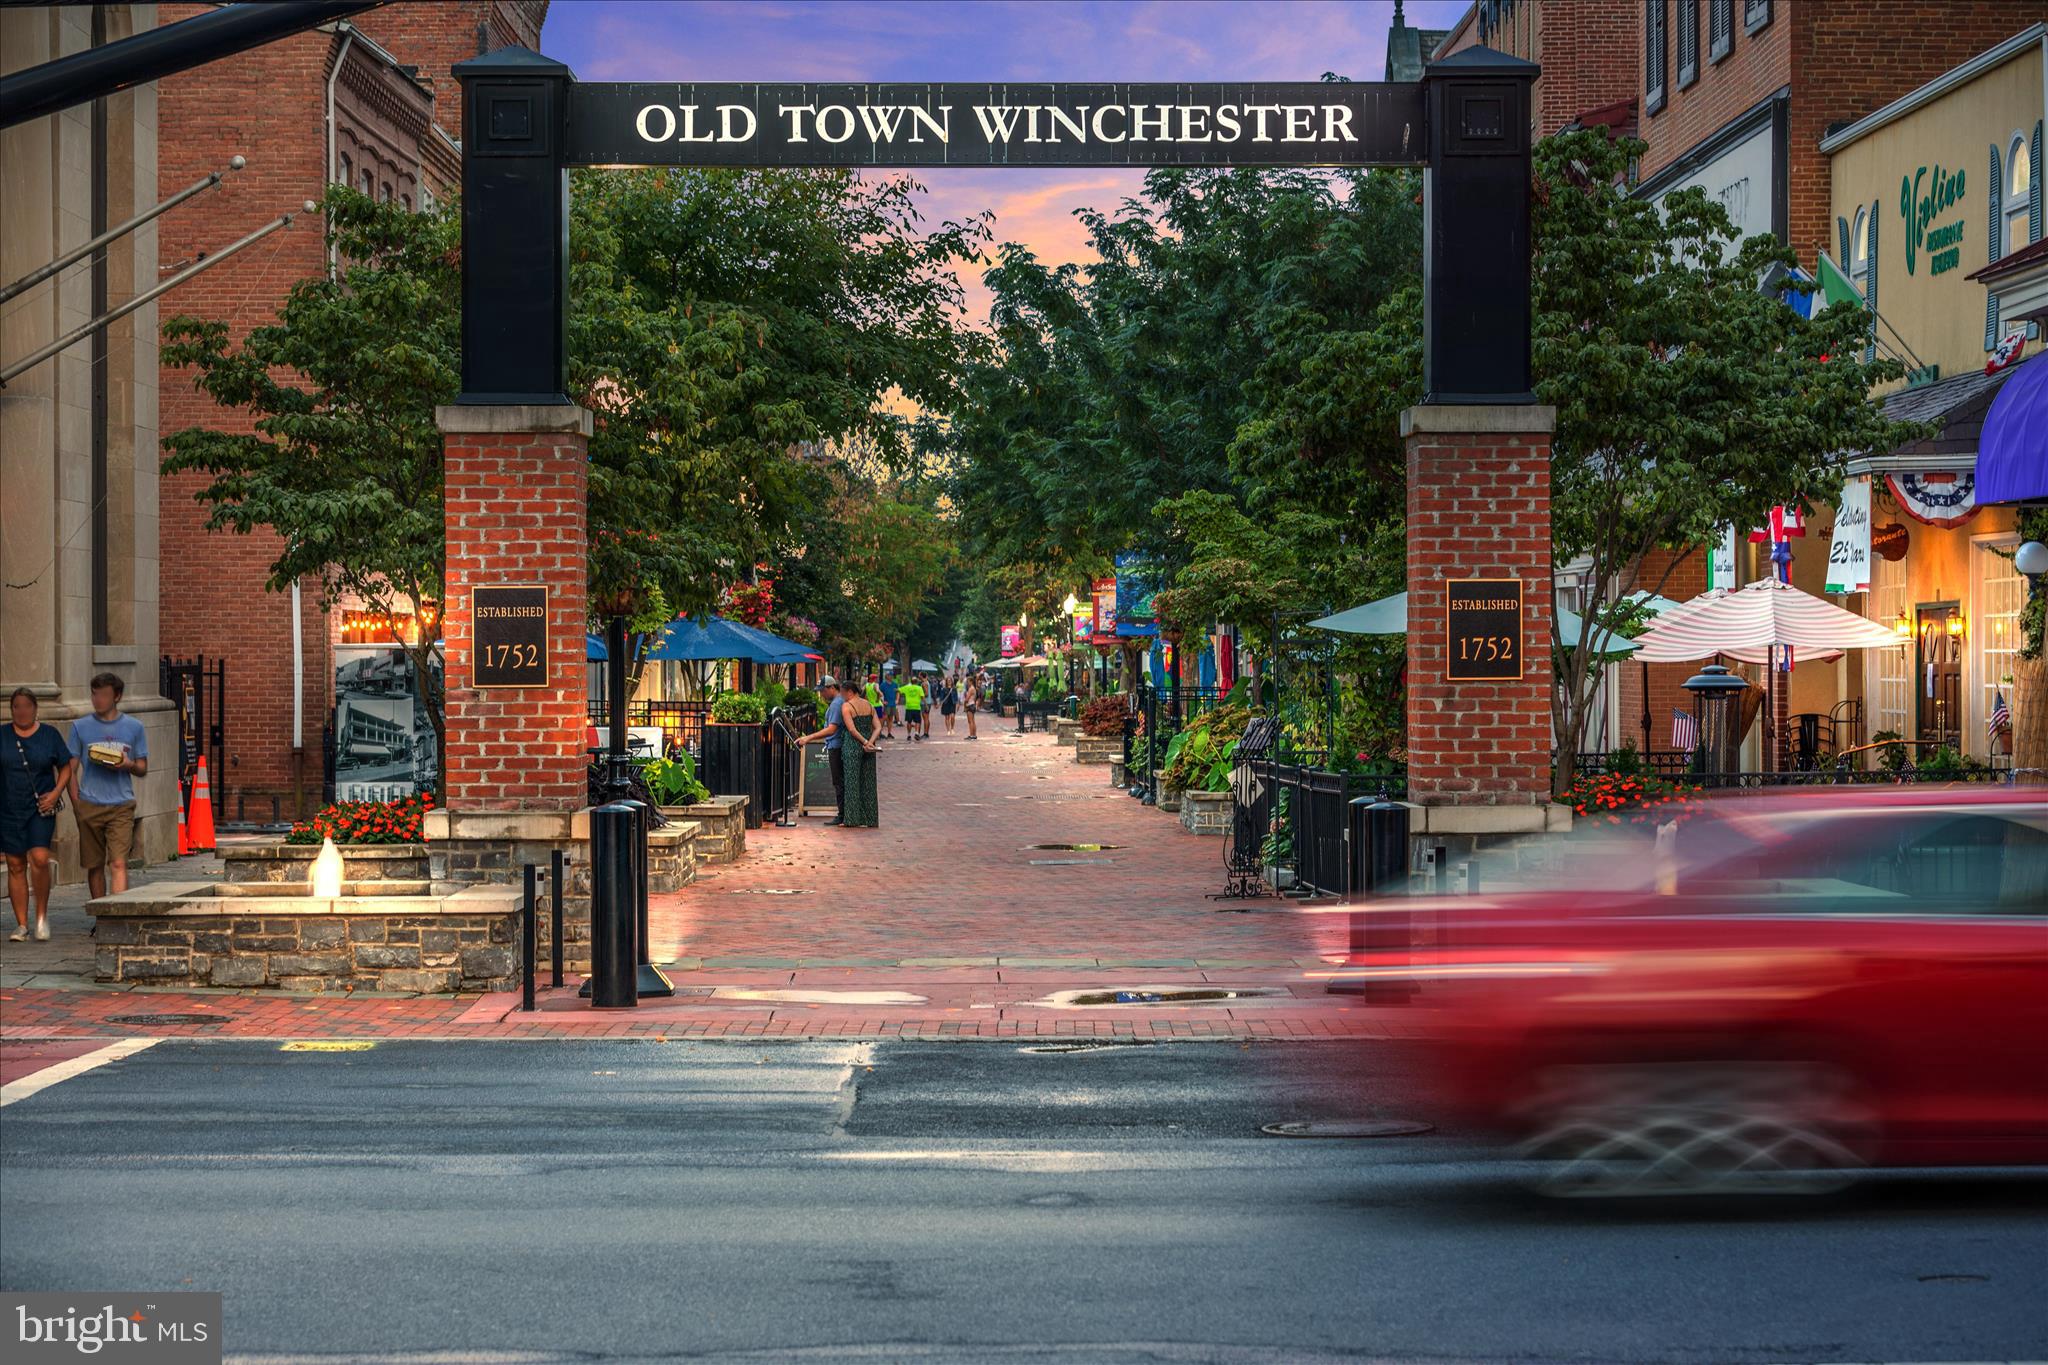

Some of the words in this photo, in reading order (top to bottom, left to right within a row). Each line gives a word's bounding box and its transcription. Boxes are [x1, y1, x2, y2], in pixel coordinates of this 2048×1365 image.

[635, 103, 757, 143] OLD
[778, 103, 951, 143] TOWN
[972, 103, 1359, 143] WINCHESTER
[1829, 540, 1849, 564] 25
[476, 606, 544, 618] ESTABLISHED
[1451, 599, 1518, 611] ESTABLISHED
[485, 643, 539, 669] 1752
[1459, 636, 1513, 662] 1752
